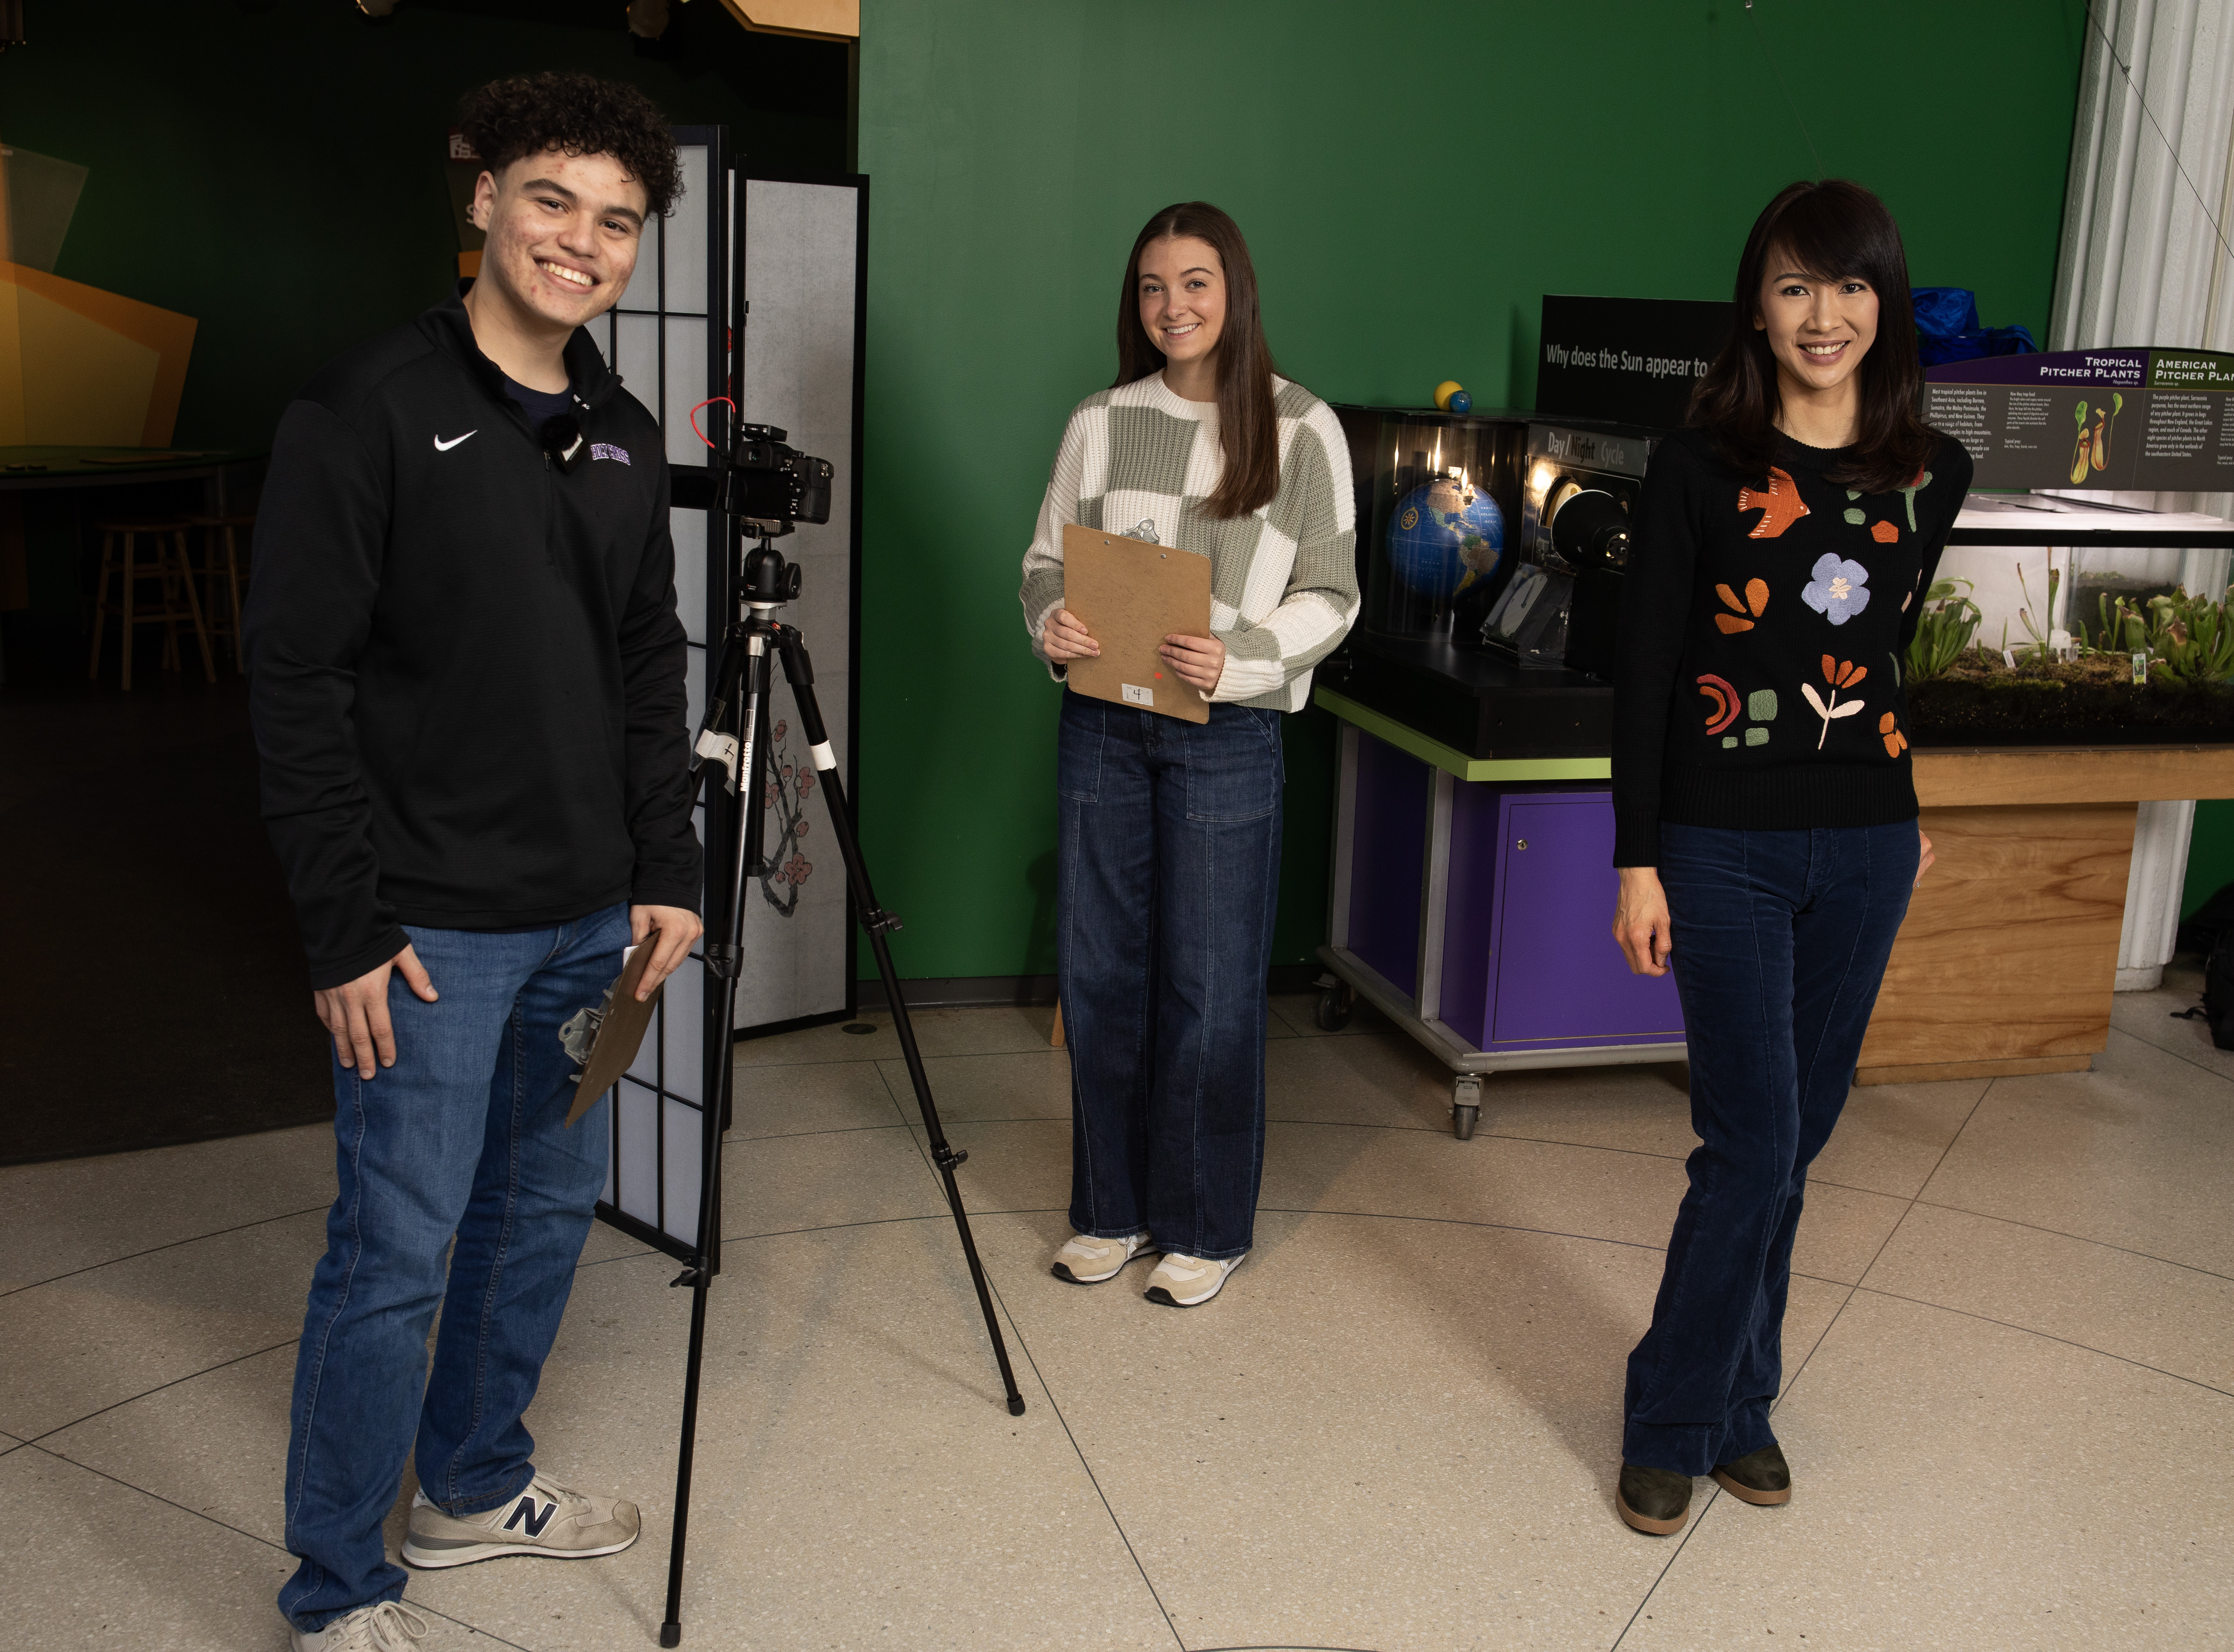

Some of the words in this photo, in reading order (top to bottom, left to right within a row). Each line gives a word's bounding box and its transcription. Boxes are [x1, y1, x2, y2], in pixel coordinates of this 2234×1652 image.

[1547, 344, 1568, 368] Why
[1571, 346, 1596, 366] does
[1599, 348, 1618, 369] the
[1621, 350, 1643, 372] Sun
[1646, 356, 1691, 378] appear
[1694, 358, 1707, 377] to
[2085, 357, 2141, 368] TROPICAL
[2157, 359, 2216, 369] AMERICAN
[2040, 367, 2091, 377] PITCHER
[2095, 368, 2140, 378] PLANTS
[2155, 370, 2204, 380] PITCHER
[590, 444, 609, 460] HOLY
[607, 444, 631, 466] CROSS
[1601, 441, 1624, 468] Cycle
[1133, 688, 1141, 700] 4
[740, 741, 751, 792] Manfrotto
[500, 1494, 560, 1539] N
